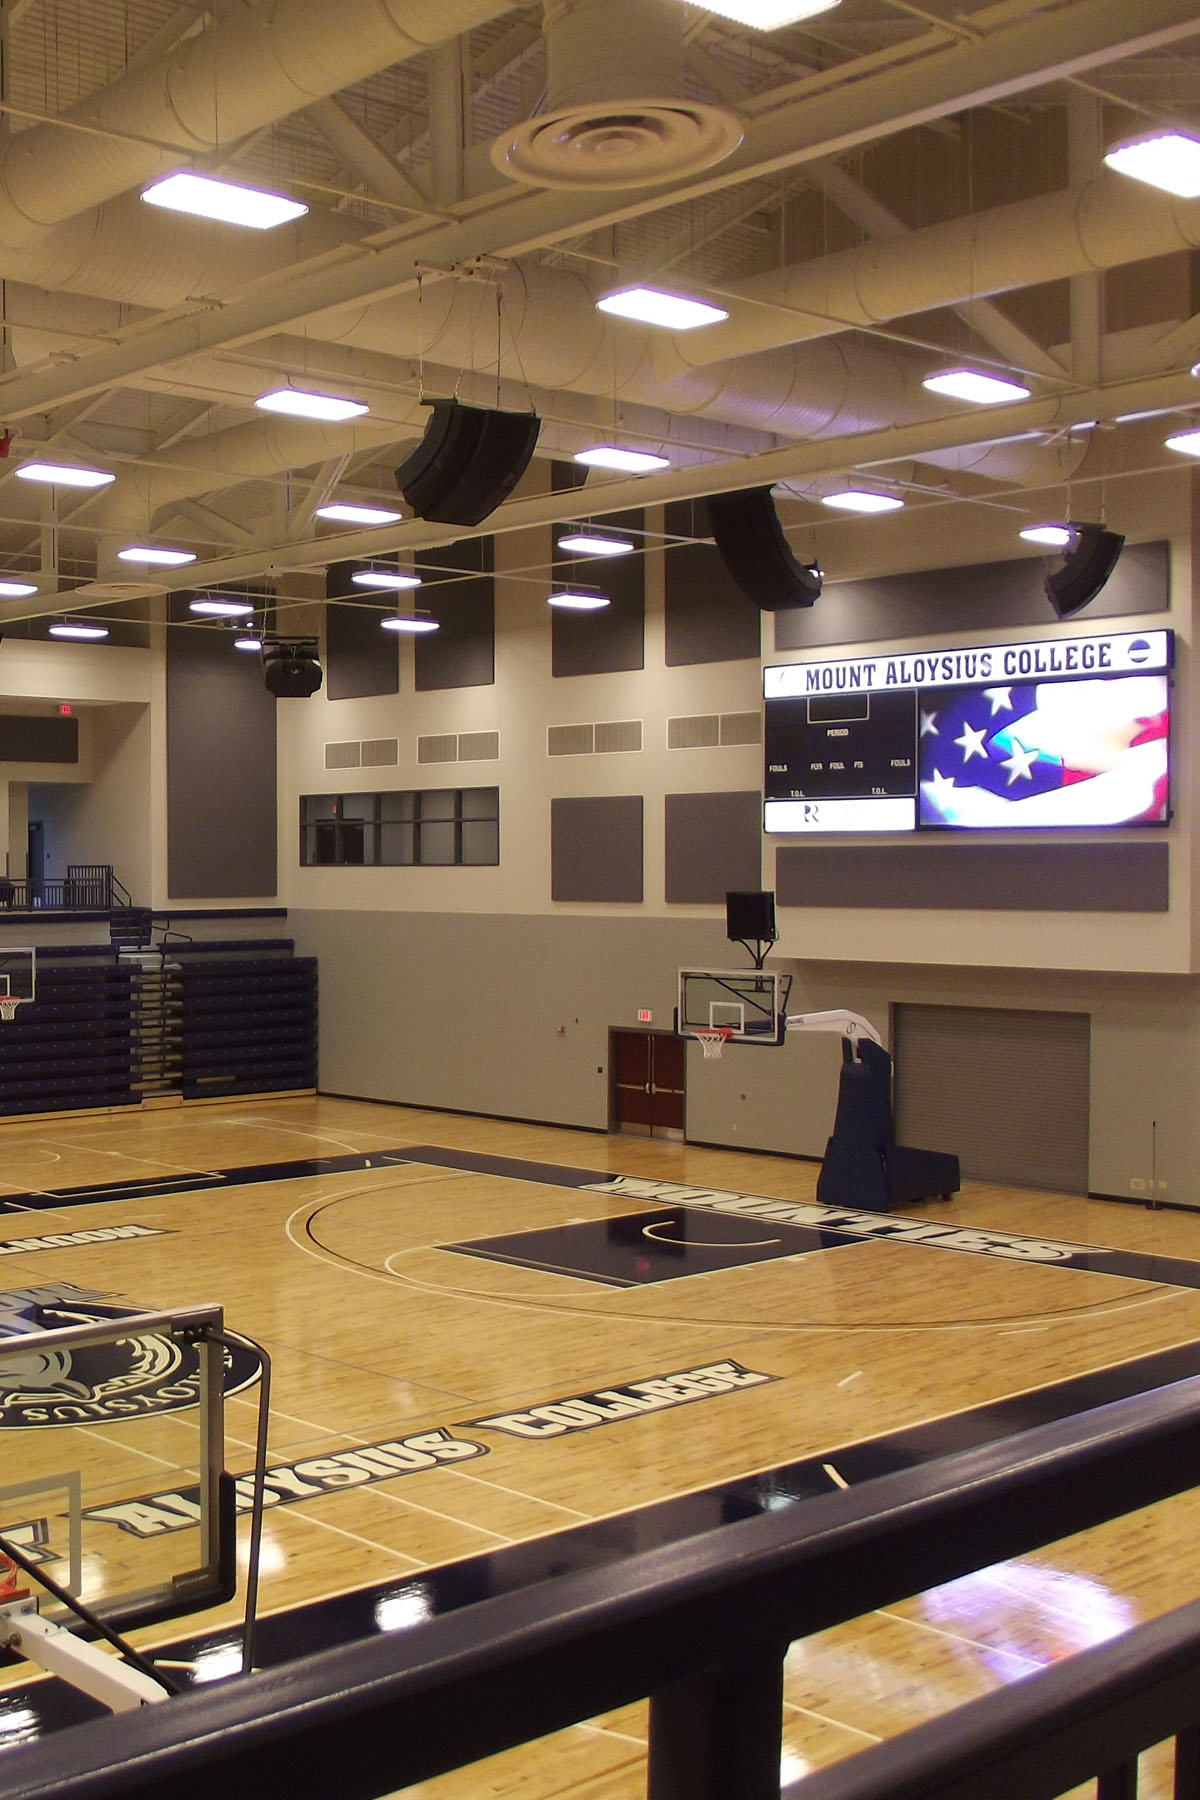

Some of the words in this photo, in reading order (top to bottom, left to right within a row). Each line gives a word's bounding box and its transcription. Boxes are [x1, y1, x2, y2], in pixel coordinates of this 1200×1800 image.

[805, 664, 876, 692] MOUNT
[885, 653, 992, 685] ALOYSIUS
[1003, 642, 1112, 676] COLLEGE
[826, 728, 849, 737] PERIOD
[769, 764, 788, 772] FOULS
[890, 758, 911, 767] FOULS
[580, 1176, 1112, 1261] MOUNTIES
[465, 1360, 776, 1439] COLLEGE
